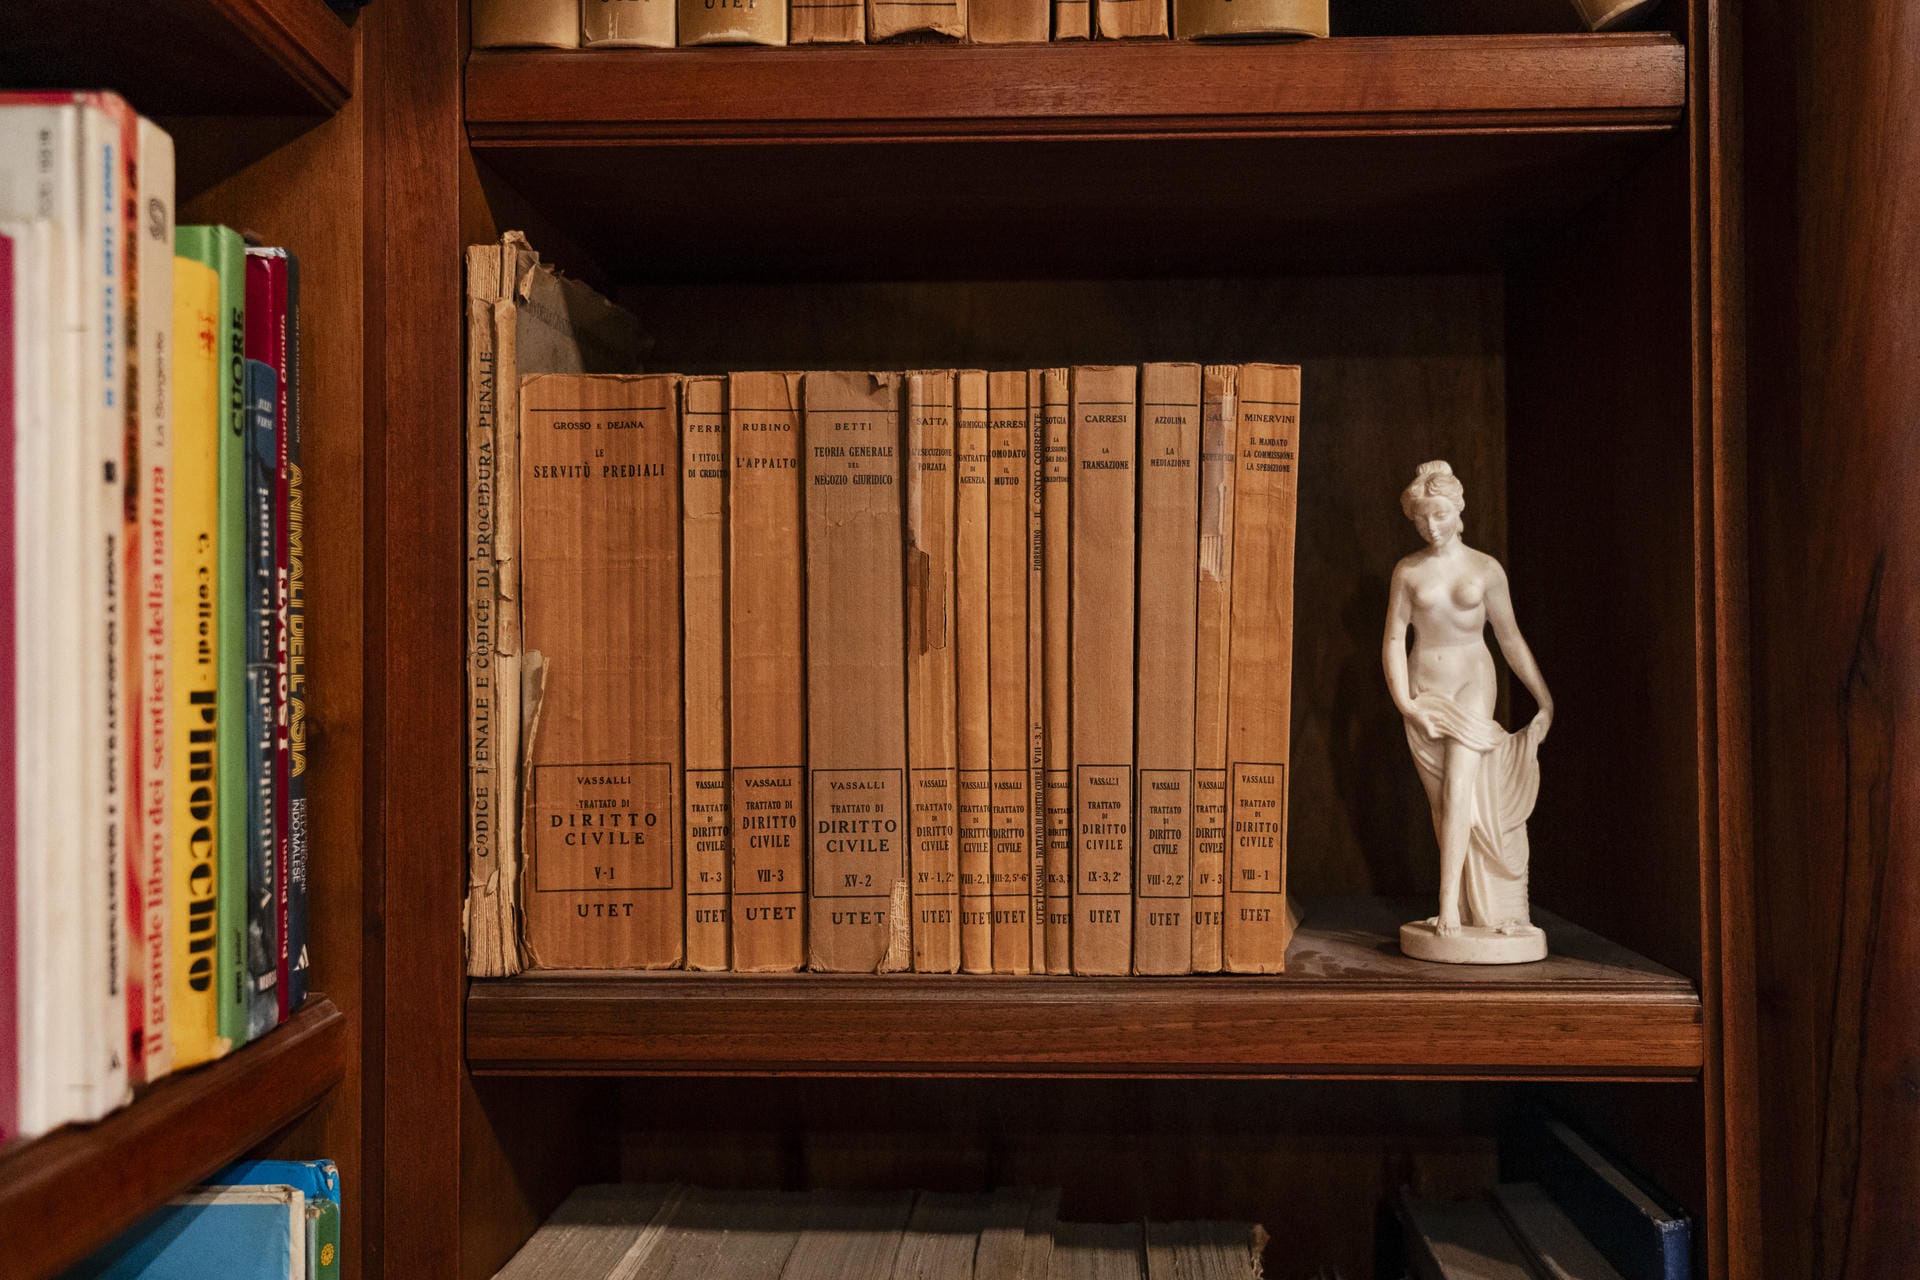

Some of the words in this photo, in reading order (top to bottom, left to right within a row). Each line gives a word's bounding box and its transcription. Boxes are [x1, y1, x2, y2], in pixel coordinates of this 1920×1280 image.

[231, 307, 243, 437] CUORE
[479, 351, 492, 428] PENALE
[916, 417, 948, 426] SATTA
[1085, 415, 1127, 424] CARRESI
[1154, 416, 1187, 425] AZZOLINA
[1244, 414, 1295, 424] MINERVINI
[553, 421, 591, 430] GROSSO
[607, 421, 644, 429] DEJANA
[742, 423, 791, 432] RUBINO
[835, 423, 872, 431] BETTI
[1033, 413, 1042, 466] CORRENTE
[1259, 438, 1288, 447] MANDATO
[595, 449, 604, 458] LE
[814, 447, 844, 457] TEORIA
[849, 446, 893, 457] GENERALE
[1165, 448, 1174, 456] LA
[1243, 450, 1252, 458] LA
[1253, 450, 1294, 460] COMMISSIONE
[692, 453, 695, 462] I
[699, 453, 725, 462] TITOLI
[736, 458, 797, 469] L'APPALTO
[1082, 460, 1129, 470] TRANSAZIONE
[1150, 459, 1191, 468] MEDIAZIONE
[1246, 463, 1254, 471] LA
[1256, 463, 1290, 473] SPEDIZIONE
[534, 461, 591, 479] SERVITÙ
[603, 463, 665, 478] PREDIALI
[688, 469, 696, 478] DI
[814, 475, 848, 486] NEGOZIO
[852, 474, 893, 485] GIURIDICO
[960, 476, 986, 484] AGENZIA
[994, 476, 1020, 486] MUTUO
[1033, 471, 1041, 505] CONTO
[477, 441, 491, 559] PROCEDURA
[150, 466, 163, 566] natura
[258, 487, 269, 557] mari
[289, 462, 304, 608] ANIMALI
[477, 569, 490, 588] DI
[148, 573, 163, 645] della
[260, 588, 270, 660] sotto
[476, 599, 490, 669] CODICE
[277, 566, 288, 727] SOLDATI
[477, 676, 489, 688] E
[149, 653, 163, 769] sentieri
[259, 669, 272, 749] leghe
[278, 738, 288, 750] I
[577, 776, 631, 785] VASSALLI
[696, 781, 725, 789] VASSALLI
[745, 779, 792, 787] VASSALLI
[919, 780, 948, 788] VASSALLI
[1242, 775, 1275, 785] VASSALLI
[830, 782, 885, 791] VASSALLI
[994, 782, 1022, 790] VASSALLI
[1151, 782, 1180, 791] VASSALLI
[148, 779, 163, 825] dei
[578, 800, 617, 809] TRATTATO
[621, 800, 630, 808] DI
[746, 801, 782, 810] TRATTATO
[785, 801, 793, 809] DI
[916, 803, 952, 811] TRATTATO
[1088, 801, 1121, 810] TRATTATO
[1240, 799, 1276, 808] TRATTATO
[692, 804, 728, 813] TRATTATO
[831, 804, 871, 813] TRATTATO
[875, 804, 884, 813] DI
[993, 806, 1024, 814] TRATTATO
[1150, 806, 1182, 814] TRATTATO
[477, 786, 489, 858] CODICE
[551, 813, 657, 828] DIRITTO
[742, 815, 797, 829] DIRITTO
[692, 826, 729, 838] DIRITTO
[818, 820, 897, 834] DIRITTO
[916, 825, 953, 837] DIRITTO
[1082, 823, 1127, 834] DIRITTO
[1236, 822, 1278, 834] DIRITTO
[259, 760, 272, 909] Ventimila
[565, 832, 645, 846] CIVILE
[992, 828, 1024, 839] DIRITTO
[1149, 829, 1182, 840] DIRITTO
[190, 691, 216, 992] Pinocchio
[696, 841, 726, 852] CIVILE
[750, 835, 791, 849] CIVILE
[826, 839, 890, 853] CIVILE
[921, 840, 950, 851] CIVILE
[1086, 839, 1123, 850] CIVILE
[1240, 837, 1274, 849] CIVILE
[964, 842, 989, 853] CIVILE
[997, 842, 1022, 853] CIVILE
[1153, 844, 1178, 855] CIVILE
[1199, 843, 1223, 853] CIVILE
[148, 833, 163, 908] libro
[577, 903, 634, 918] UTET
[696, 909, 727, 923] UTET
[746, 907, 797, 921] UTET
[1036, 900, 1044, 925] UTET
[1240, 909, 1271, 923] UTET
[832, 911, 886, 925] UTET
[922, 910, 953, 924] UTET
[995, 910, 1026, 923] UTET
[1089, 910, 1121, 923] UTET
[1150, 912, 1180, 926] UTET
[148, 914, 164, 1026] grande
[147, 1033, 163, 1055] il
